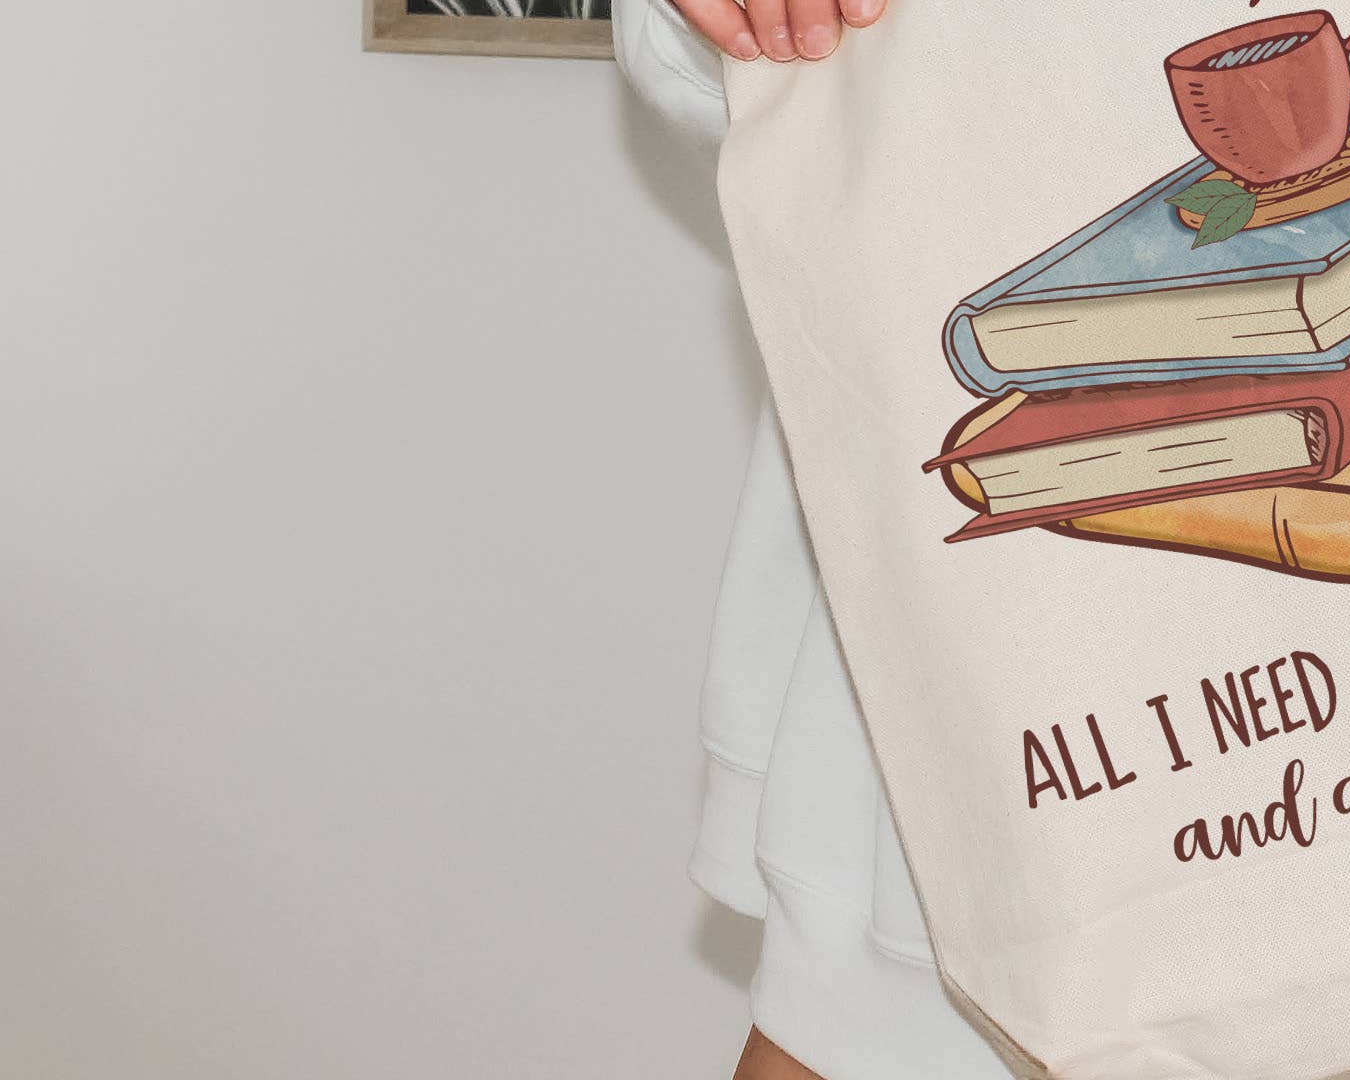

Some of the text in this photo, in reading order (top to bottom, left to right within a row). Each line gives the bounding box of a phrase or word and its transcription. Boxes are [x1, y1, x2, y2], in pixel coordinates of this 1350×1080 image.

[1024, 714, 1137, 808] ALL
[1146, 695, 1192, 771] I
[1201, 651, 1336, 754] NEED
[1174, 759, 1316, 862] and
